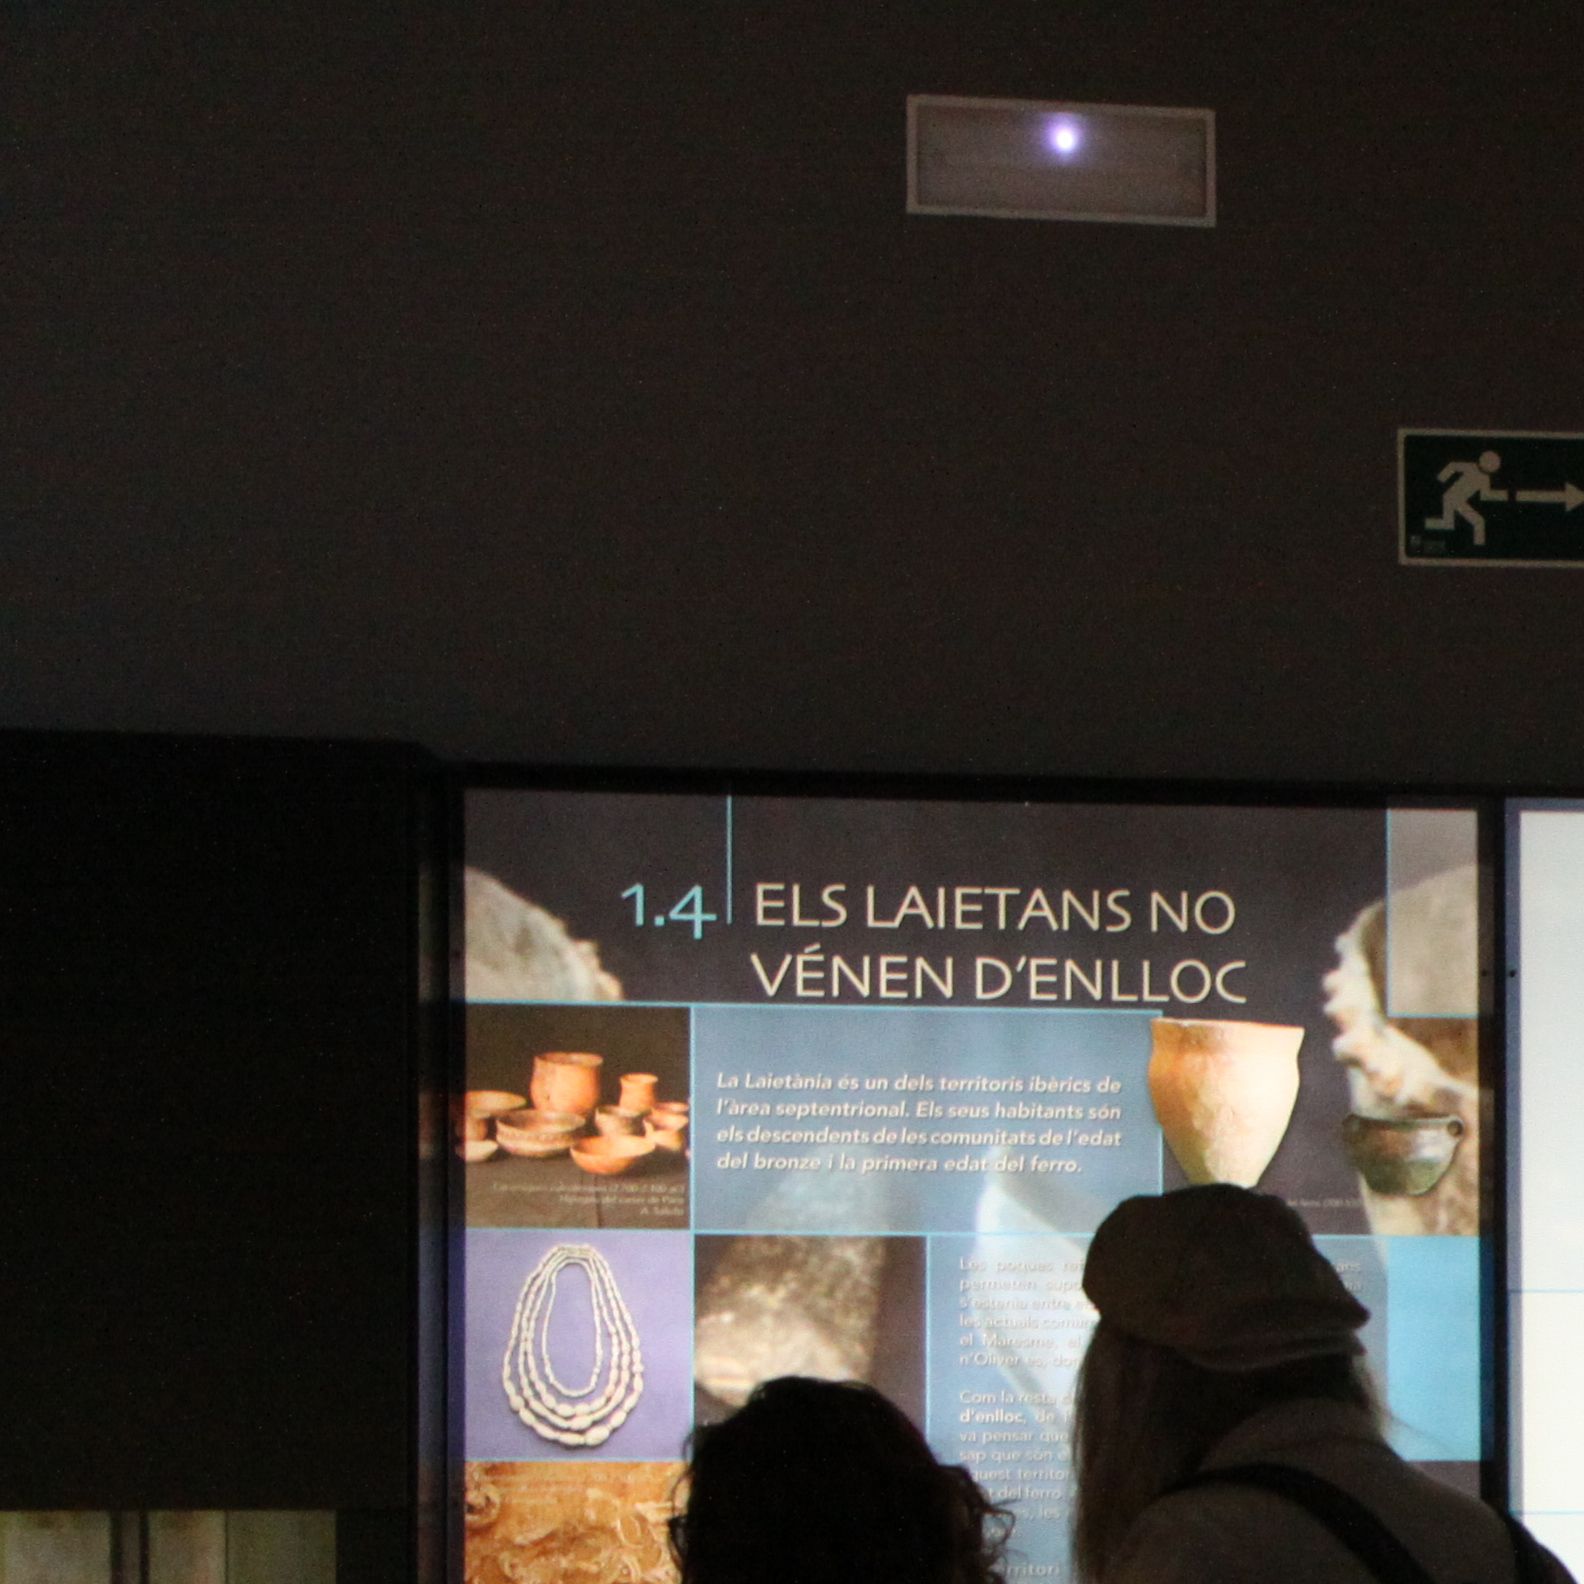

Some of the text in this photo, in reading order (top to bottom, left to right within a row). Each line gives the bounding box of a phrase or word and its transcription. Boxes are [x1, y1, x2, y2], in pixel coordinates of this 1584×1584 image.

[621, 884, 717, 940] 1.4
[755, 883, 1236, 935] ELS LAIETANS NO
[750, 943, 1248, 1005] VÉNEN D'ENLLOC
[717, 1072, 738, 1089] La
[745, 1072, 832, 1090] Laietània
[865, 1077, 888, 1090] un
[894, 1074, 934, 1092] dels
[940, 1075, 1024, 1093] territoris
[1029, 1075, 1091, 1093] ibèrics
[1097, 1076, 1122, 1093] de
[716, 1098, 1122, 1120] l'àrea septentrional. Els seus habitants són
[716, 1125, 1122, 1147] els descendents de les comunitats de l'edat
[716, 1152, 748, 1169] del
[753, 1152, 821, 1170] bronze
[839, 1153, 856, 1170] la
[861, 1154, 938, 1175] primera
[944, 1155, 987, 1172] edat
[994, 1155, 1026, 1173] del
[1030, 1155, 1083, 1173] ferro.
[960, 1390, 996, 1404] Com
[1001, 1389, 1014, 1404] la
[960, 1407, 1027, 1425] d'enlloc,
[960, 1431, 977, 1442] va
[982, 1431, 1033, 1445] pensar
[991, 1450, 1021, 1464] que
